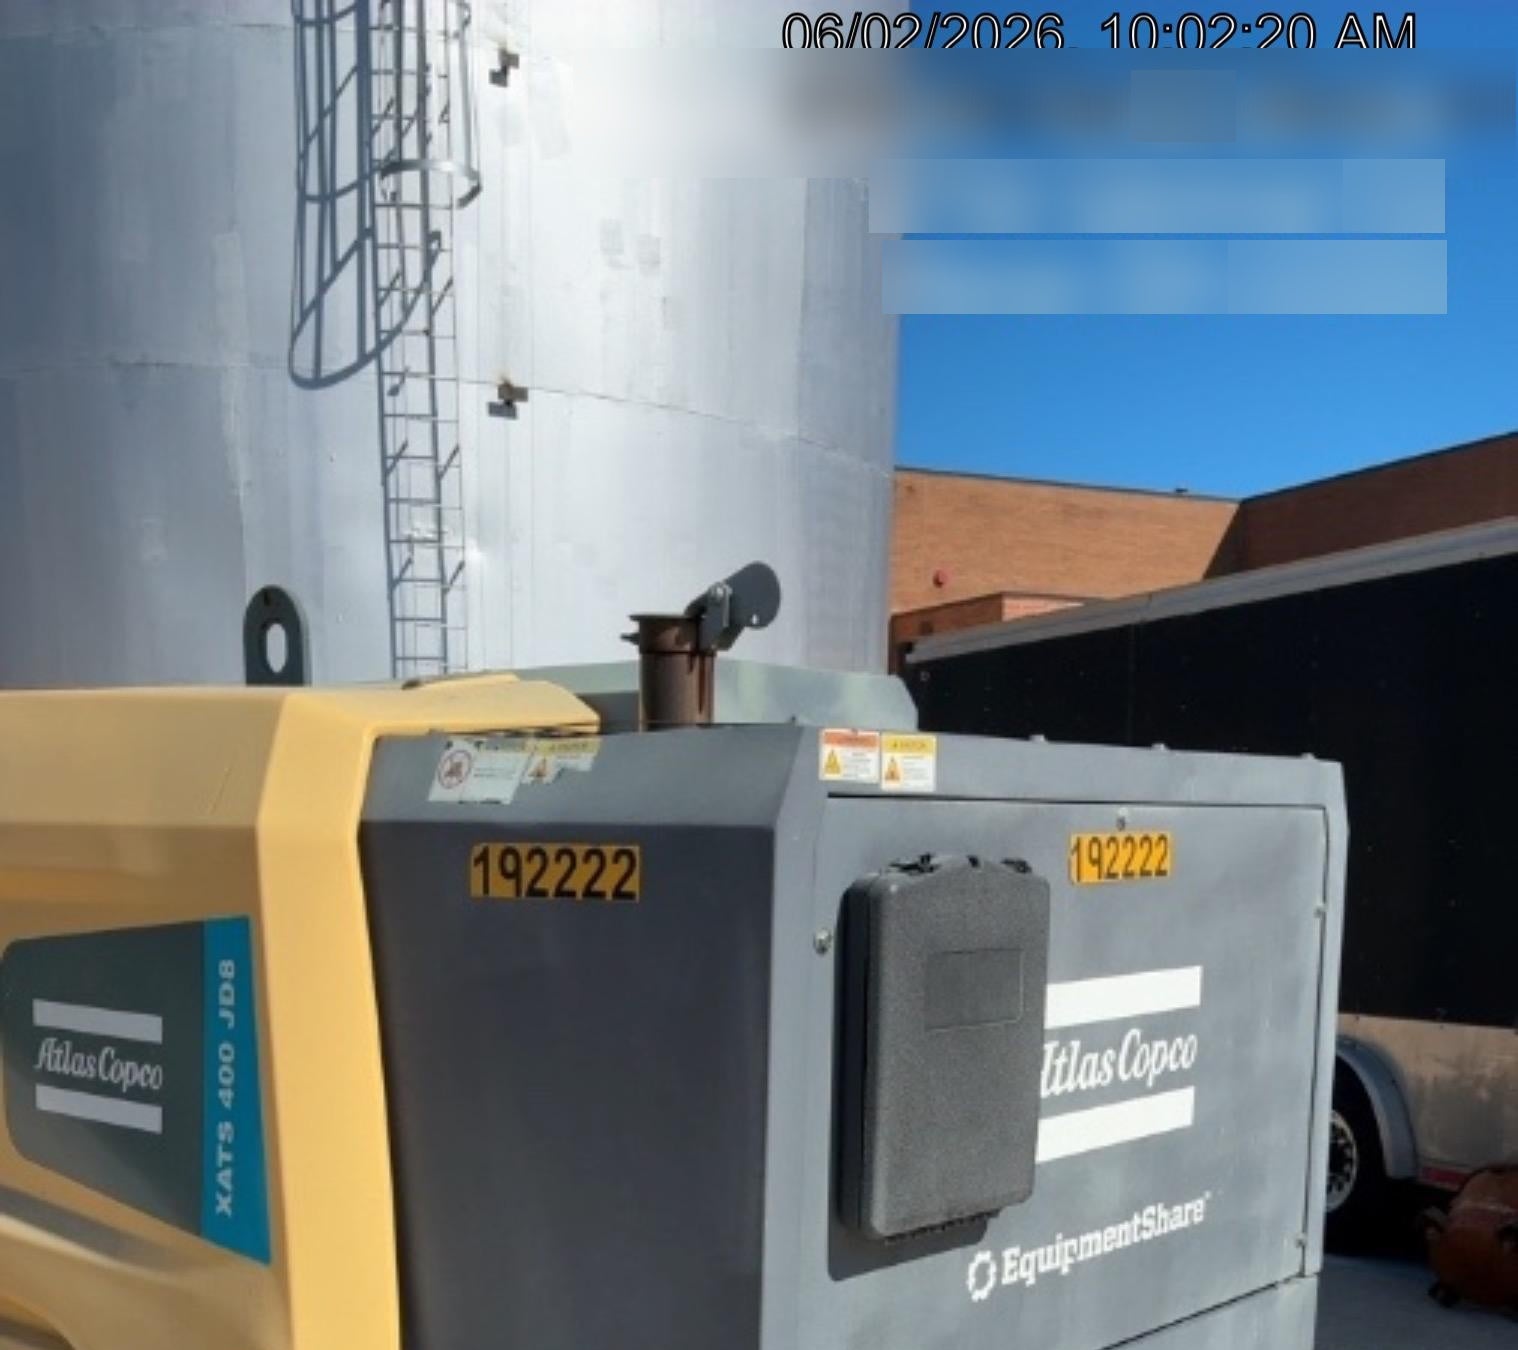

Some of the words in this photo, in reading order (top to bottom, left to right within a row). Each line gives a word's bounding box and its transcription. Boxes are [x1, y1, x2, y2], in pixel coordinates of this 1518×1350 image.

[473, 846, 638, 900] 192222
[1072, 834, 1169, 882] 192222
[218, 959, 236, 1030] JD8
[34, 1037, 97, 1081] Atlas
[99, 1047, 163, 1092] Copco
[218, 1043, 235, 1109] 400
[1118, 1028, 1198, 1088] Copco
[215, 1121, 234, 1217] XATS
[1001, 1198, 1207, 1287] EquipmentShare
